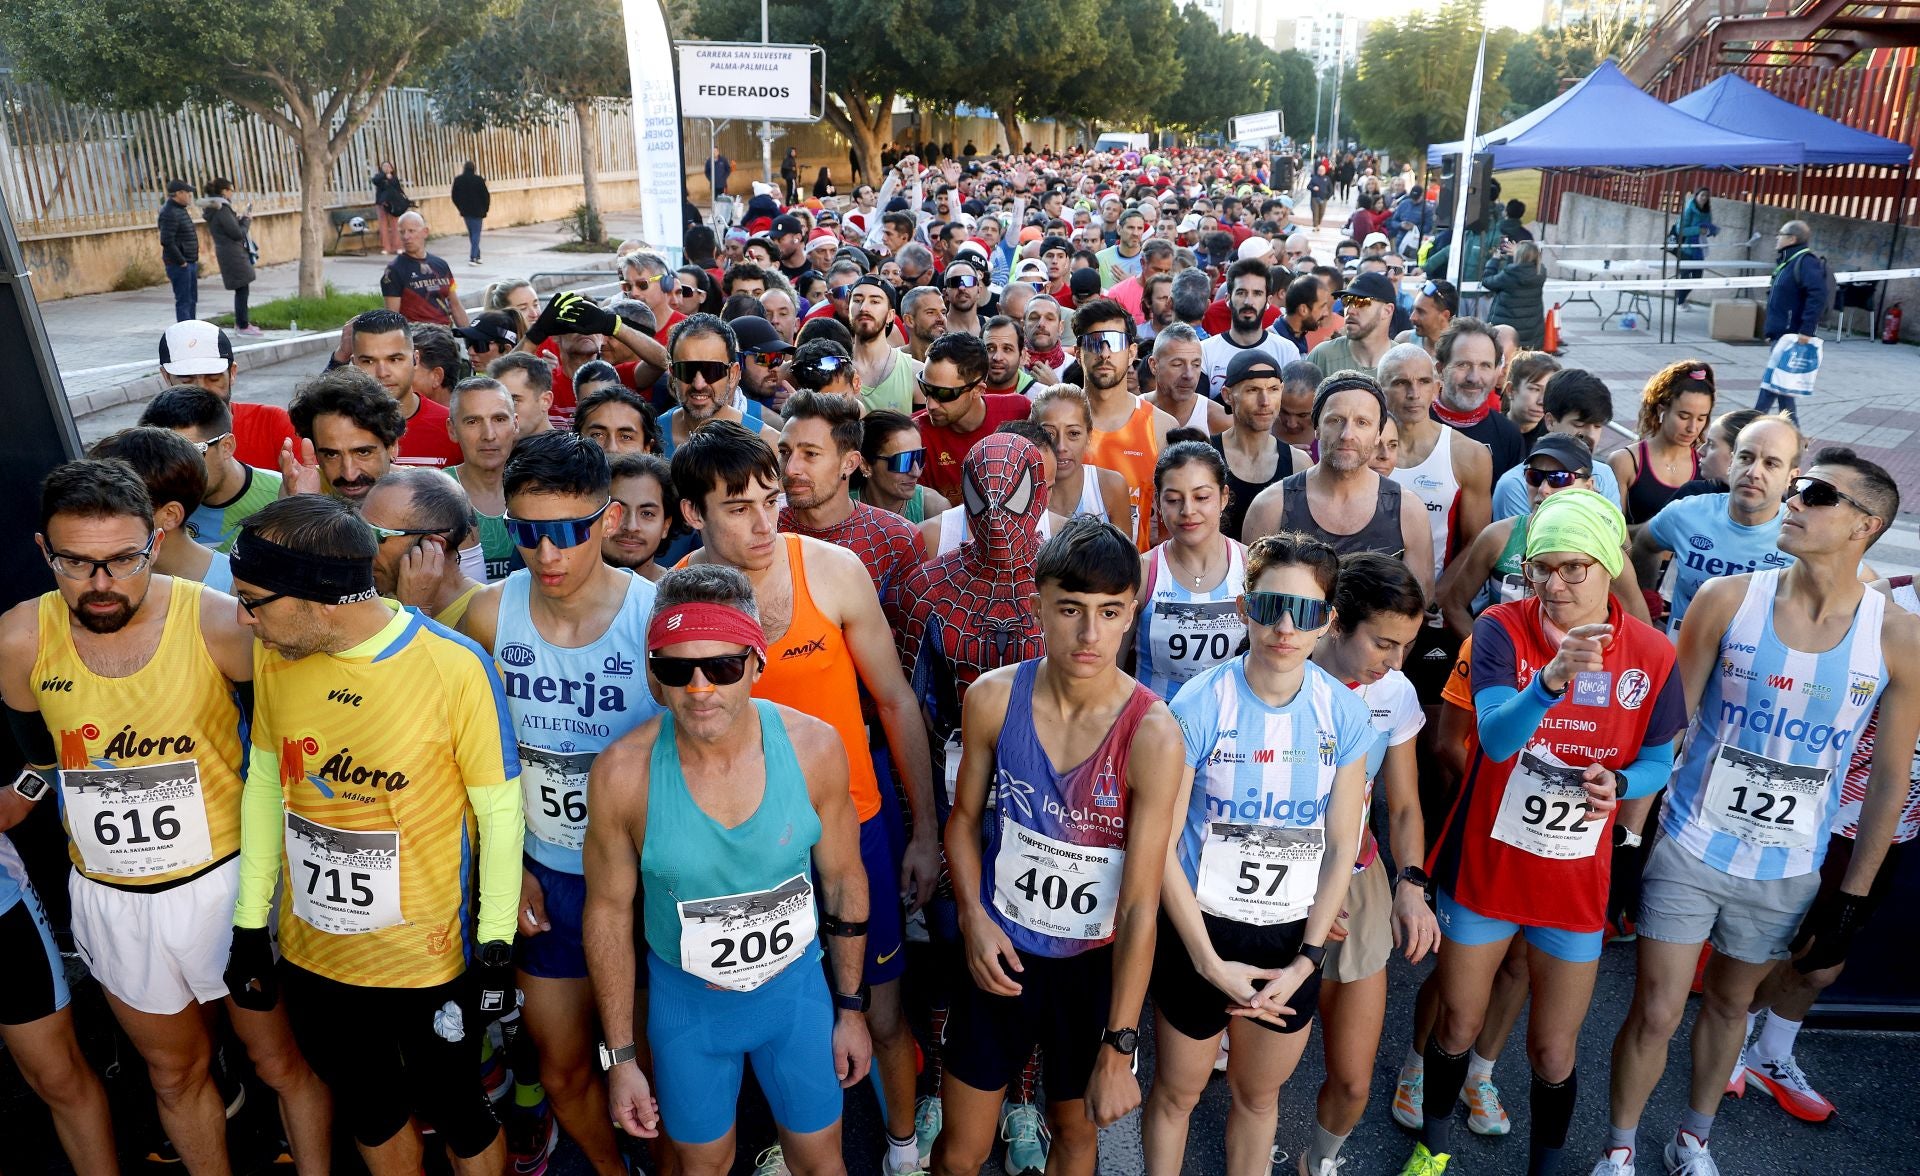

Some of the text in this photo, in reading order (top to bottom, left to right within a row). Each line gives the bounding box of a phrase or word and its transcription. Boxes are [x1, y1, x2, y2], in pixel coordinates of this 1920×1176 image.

[696, 50, 793, 60] CARRERA SAN SILVESTRE
[710, 62, 779, 71] PALMA-PALMILLA
[698, 85, 790, 98] FEDERADOS
[1691, 537, 1713, 550] TROPS
[503, 647, 534, 663] TROPS
[1168, 633, 1230, 661] 970
[603, 652, 634, 676] als
[504, 670, 627, 718] nerja
[1804, 682, 1832, 692] metro
[522, 713, 610, 738] ATLETISMO
[104, 725, 197, 760] Álora
[1555, 744, 1618, 760] FERTILIDAD
[320, 747, 410, 793] Álora
[342, 792, 376, 803] Málaga
[540, 785, 588, 823] 56
[1727, 786, 1797, 825] 122
[94, 805, 181, 846] 616
[1043, 795, 1124, 829] lapalma
[1522, 795, 1592, 832] 922
[310, 852, 338, 863] PALMA
[354, 848, 396, 857] XIV
[1017, 832, 1109, 864] COMPETICIONES 2026
[1240, 850, 1272, 859] PALMA
[302, 859, 374, 907] 715
[1014, 868, 1102, 915] 406
[1236, 861, 1288, 896] 57
[711, 919, 794, 968] 206
